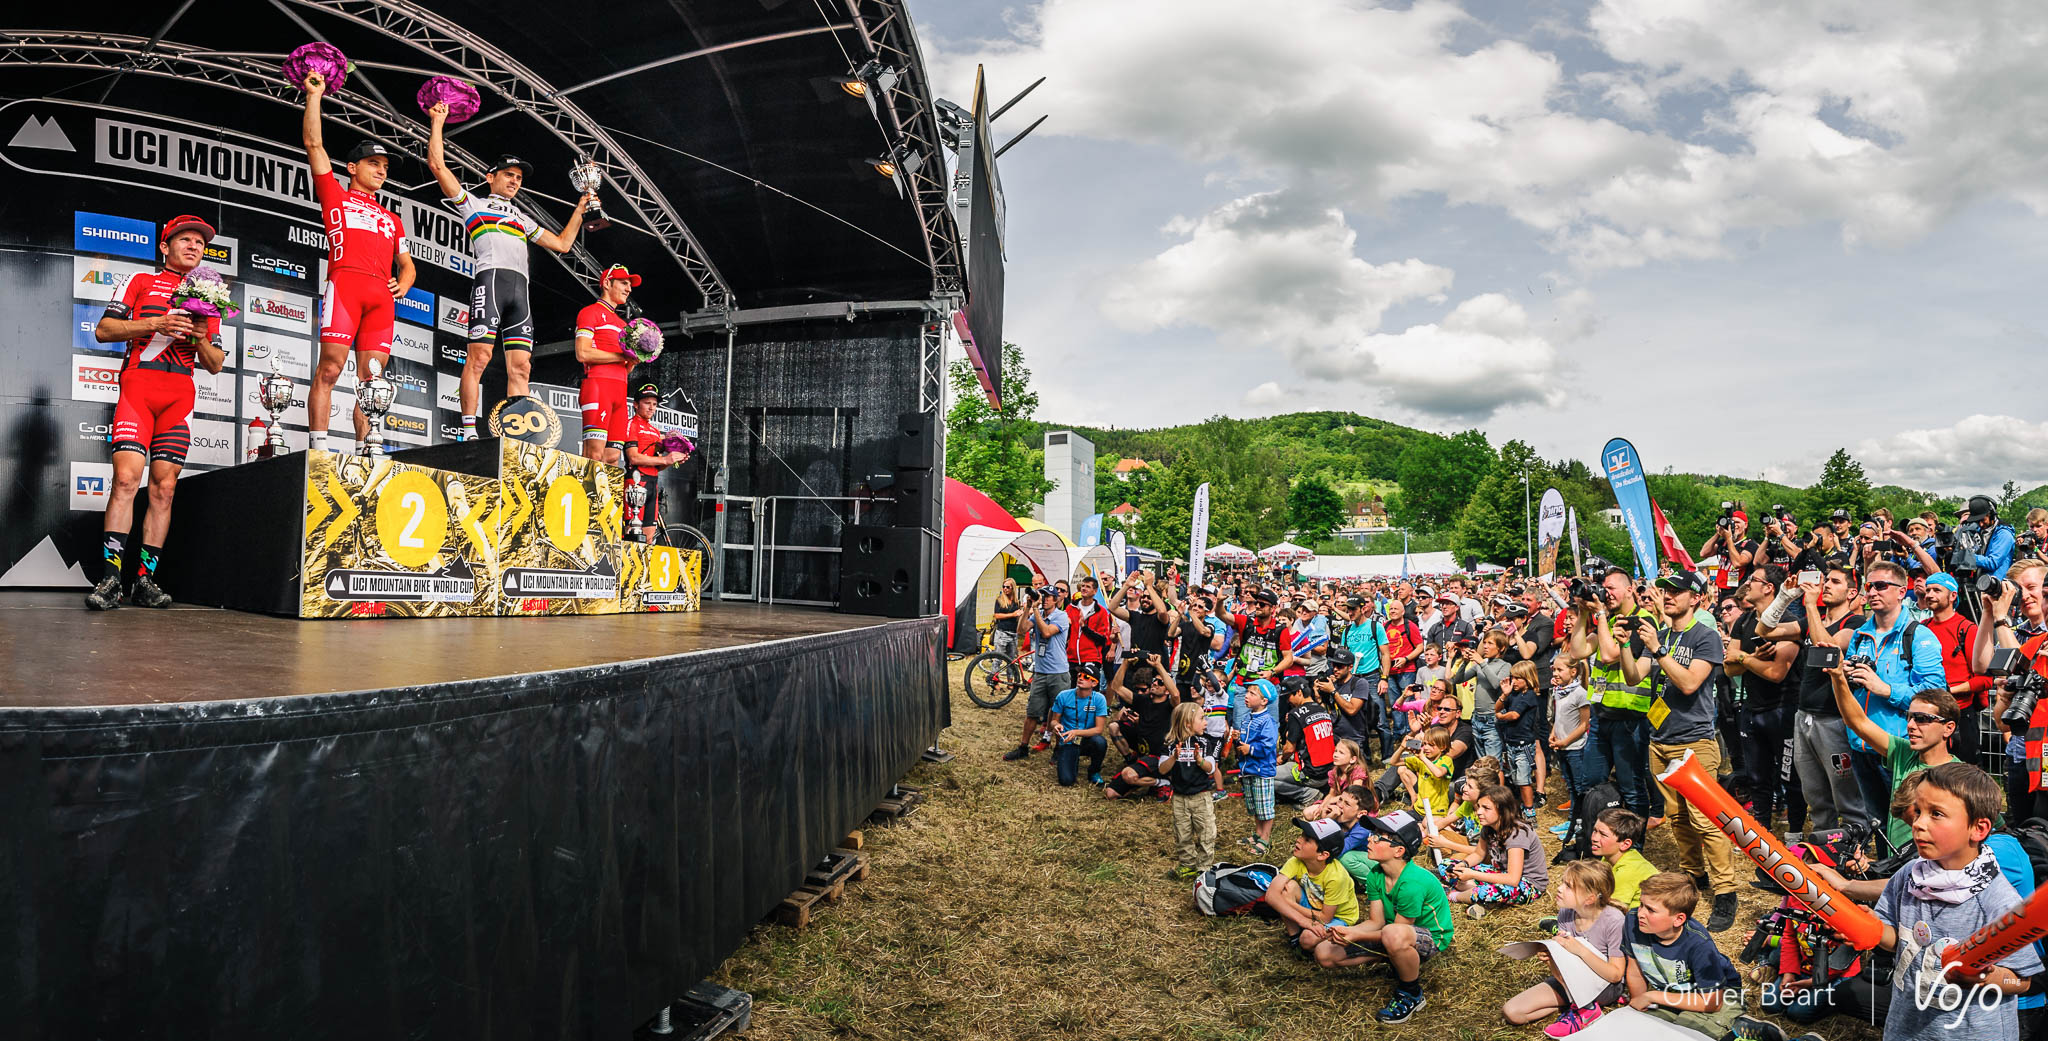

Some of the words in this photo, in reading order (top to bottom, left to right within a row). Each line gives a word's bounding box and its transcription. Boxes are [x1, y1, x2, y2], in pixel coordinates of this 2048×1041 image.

[108, 124, 168, 168] UCI
[178, 137, 350, 205] MOUNTA
[412, 205, 477, 260] WORL
[82, 226, 149, 245] SHIMANO
[251, 253, 306, 274] GoPro
[434, 249, 446, 265] BY
[450, 255, 477, 277] SH
[266, 300, 305, 320] Rothaus
[403, 337, 429, 351] SOLAR
[385, 370, 427, 388] GoPro
[552, 392, 569, 408] UCI
[386, 415, 425, 430] GONSO
[502, 411, 548, 436] 30
[681, 414, 698, 430] CUP
[193, 437, 229, 449] SOLAR
[398, 491, 426, 548] 2
[560, 493, 573, 537] 1
[659, 551, 670, 589] 3
[352, 577, 368, 592] UCI
[369, 577, 412, 593] MOUNTAIN
[413, 579, 431, 593] BIKE
[433, 580, 459, 594] WORLD
[459, 581, 473, 594] CUP
[523, 574, 535, 589] UCI
[536, 575, 569, 589] MOUNTAIN
[569, 577, 583, 590] BIKE
[584, 577, 604, 590] WORLD
[604, 578, 616, 590] CUP
[1780, 738, 1794, 782] LEGEA
